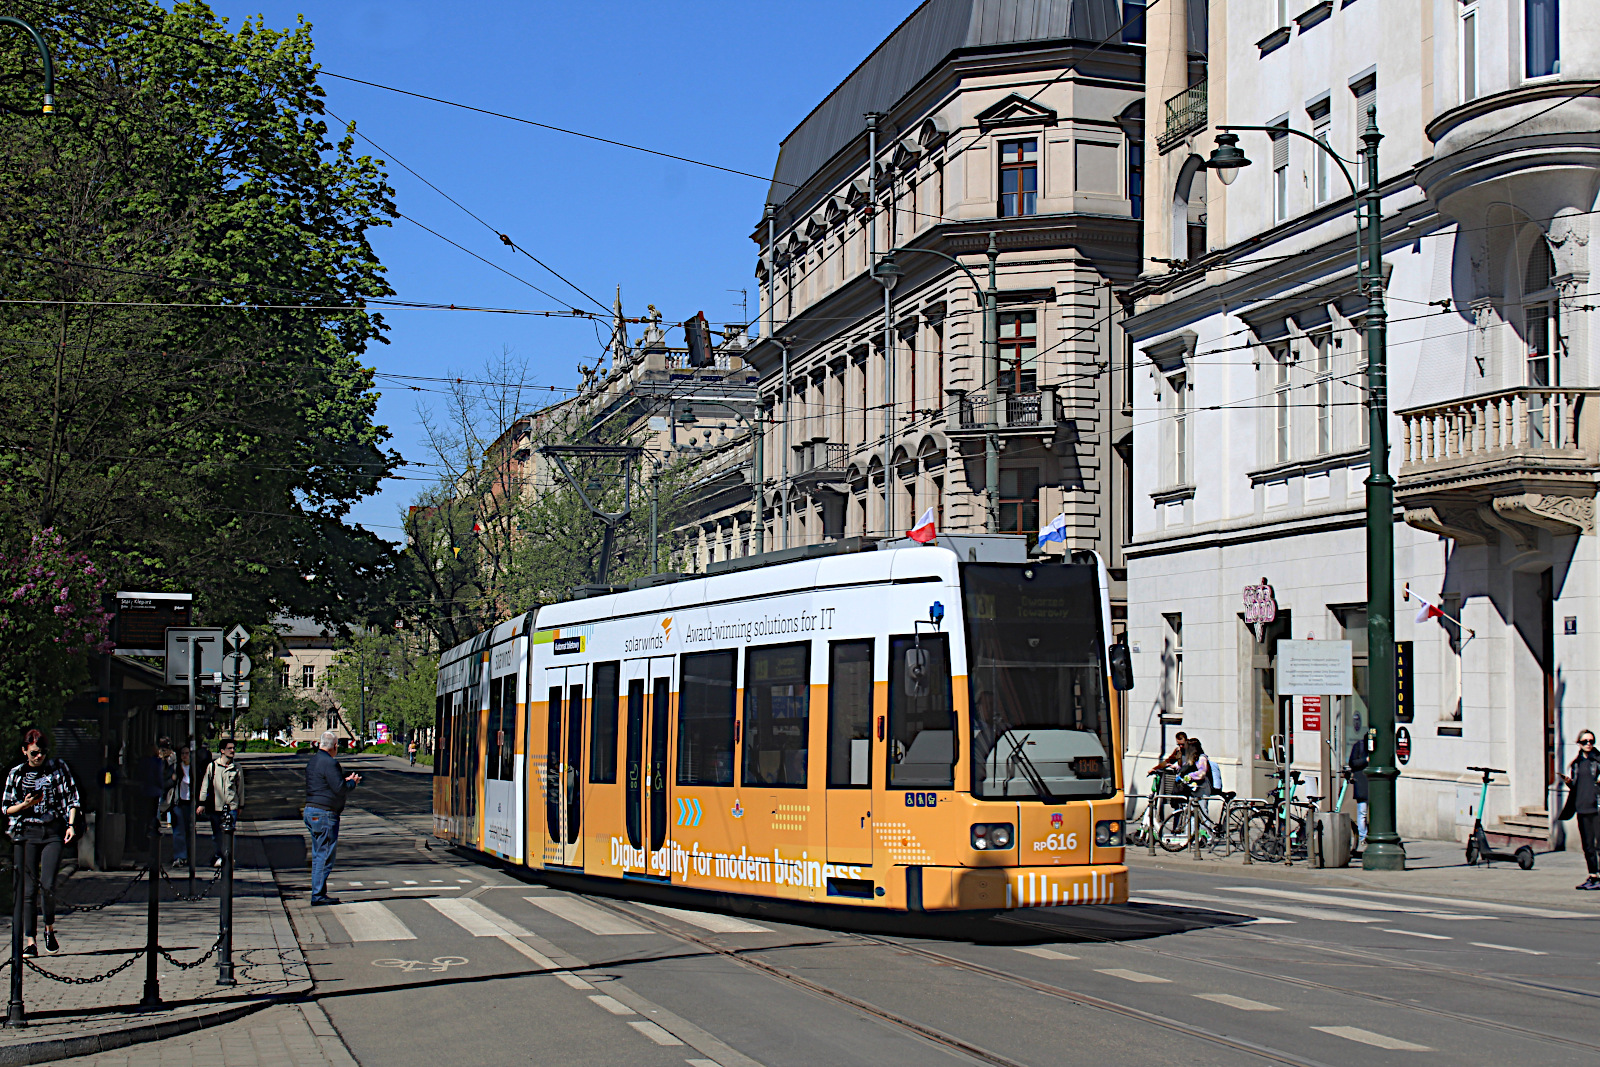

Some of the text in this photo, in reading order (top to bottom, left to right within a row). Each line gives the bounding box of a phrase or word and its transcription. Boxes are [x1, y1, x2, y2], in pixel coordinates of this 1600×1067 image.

[624, 632, 663, 653] solarwinds
[685, 608, 836, 643] Award-winning solutions for IT
[611, 836, 862, 888] Digita agility for modern business
